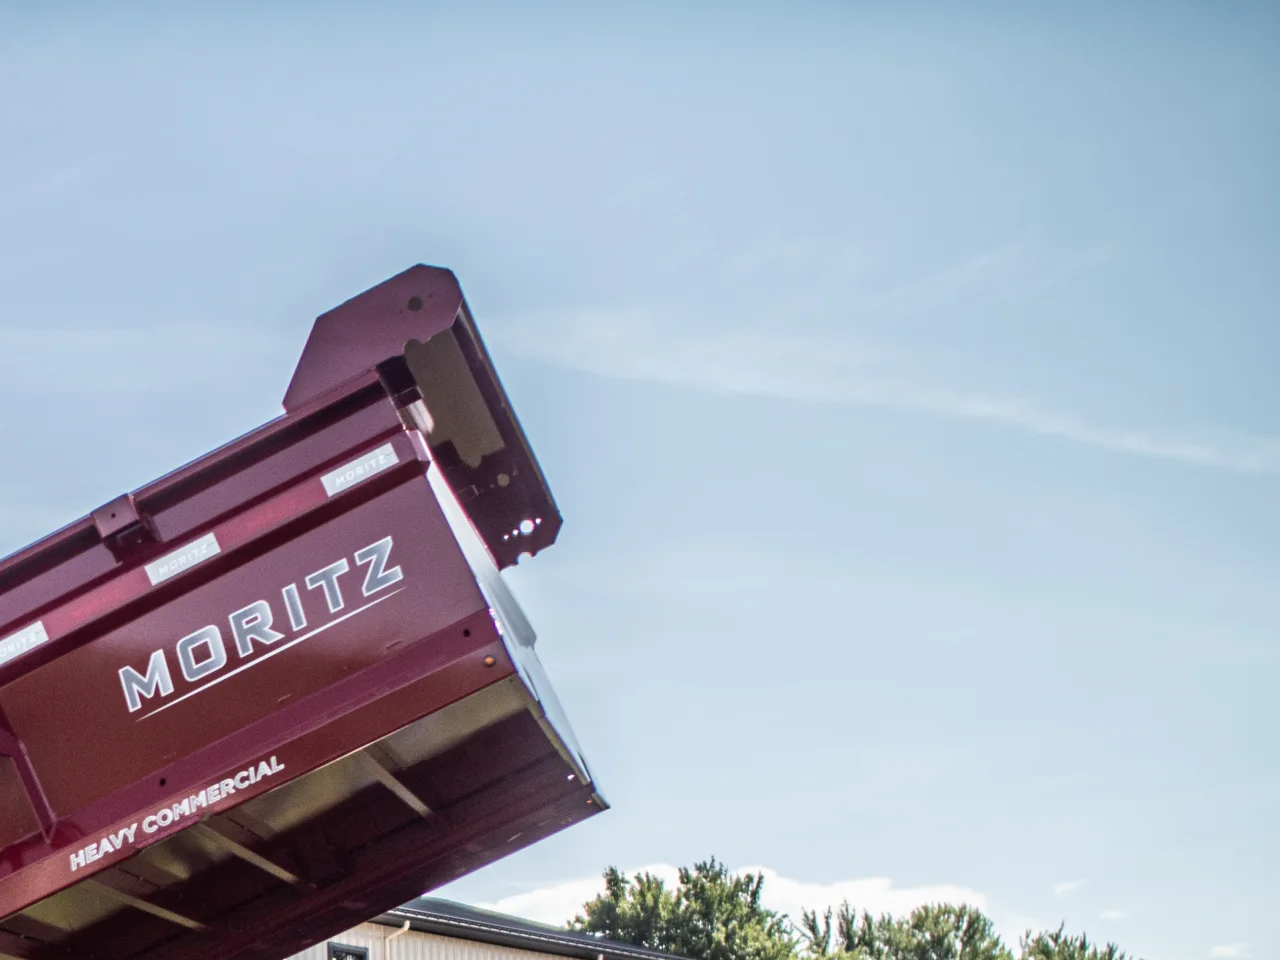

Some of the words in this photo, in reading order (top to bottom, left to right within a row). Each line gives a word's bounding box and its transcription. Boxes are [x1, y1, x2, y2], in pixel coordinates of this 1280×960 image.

[117, 534, 405, 714] MORITZ
[69, 823, 138, 872] HEAVY
[141, 755, 286, 834] COMMERCIAL
